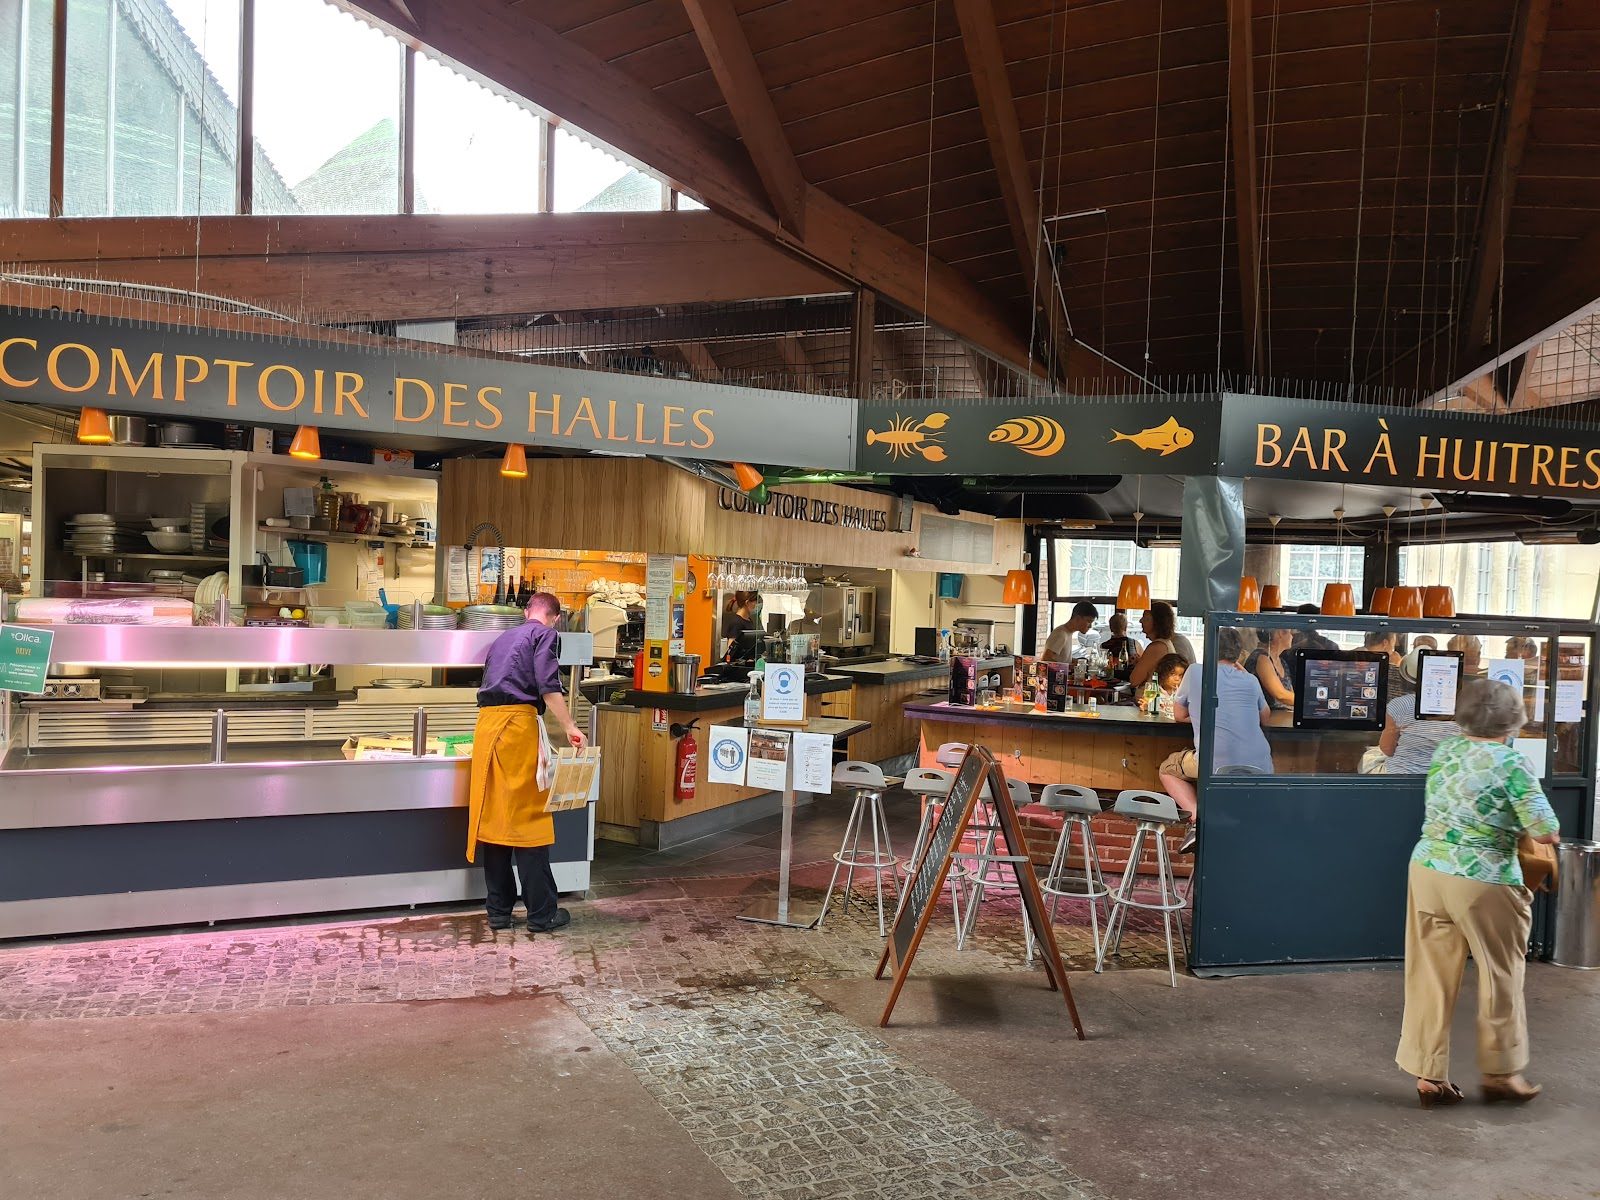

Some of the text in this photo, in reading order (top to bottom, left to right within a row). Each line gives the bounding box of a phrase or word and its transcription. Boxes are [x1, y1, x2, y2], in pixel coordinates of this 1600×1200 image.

[0, 337, 716, 449] COMPTOIR DES HALLES
[1255, 418, 1600, 490] BAR À HUITRES
[811, 499, 839, 526] DES
[841, 504, 887, 532] HALLES
